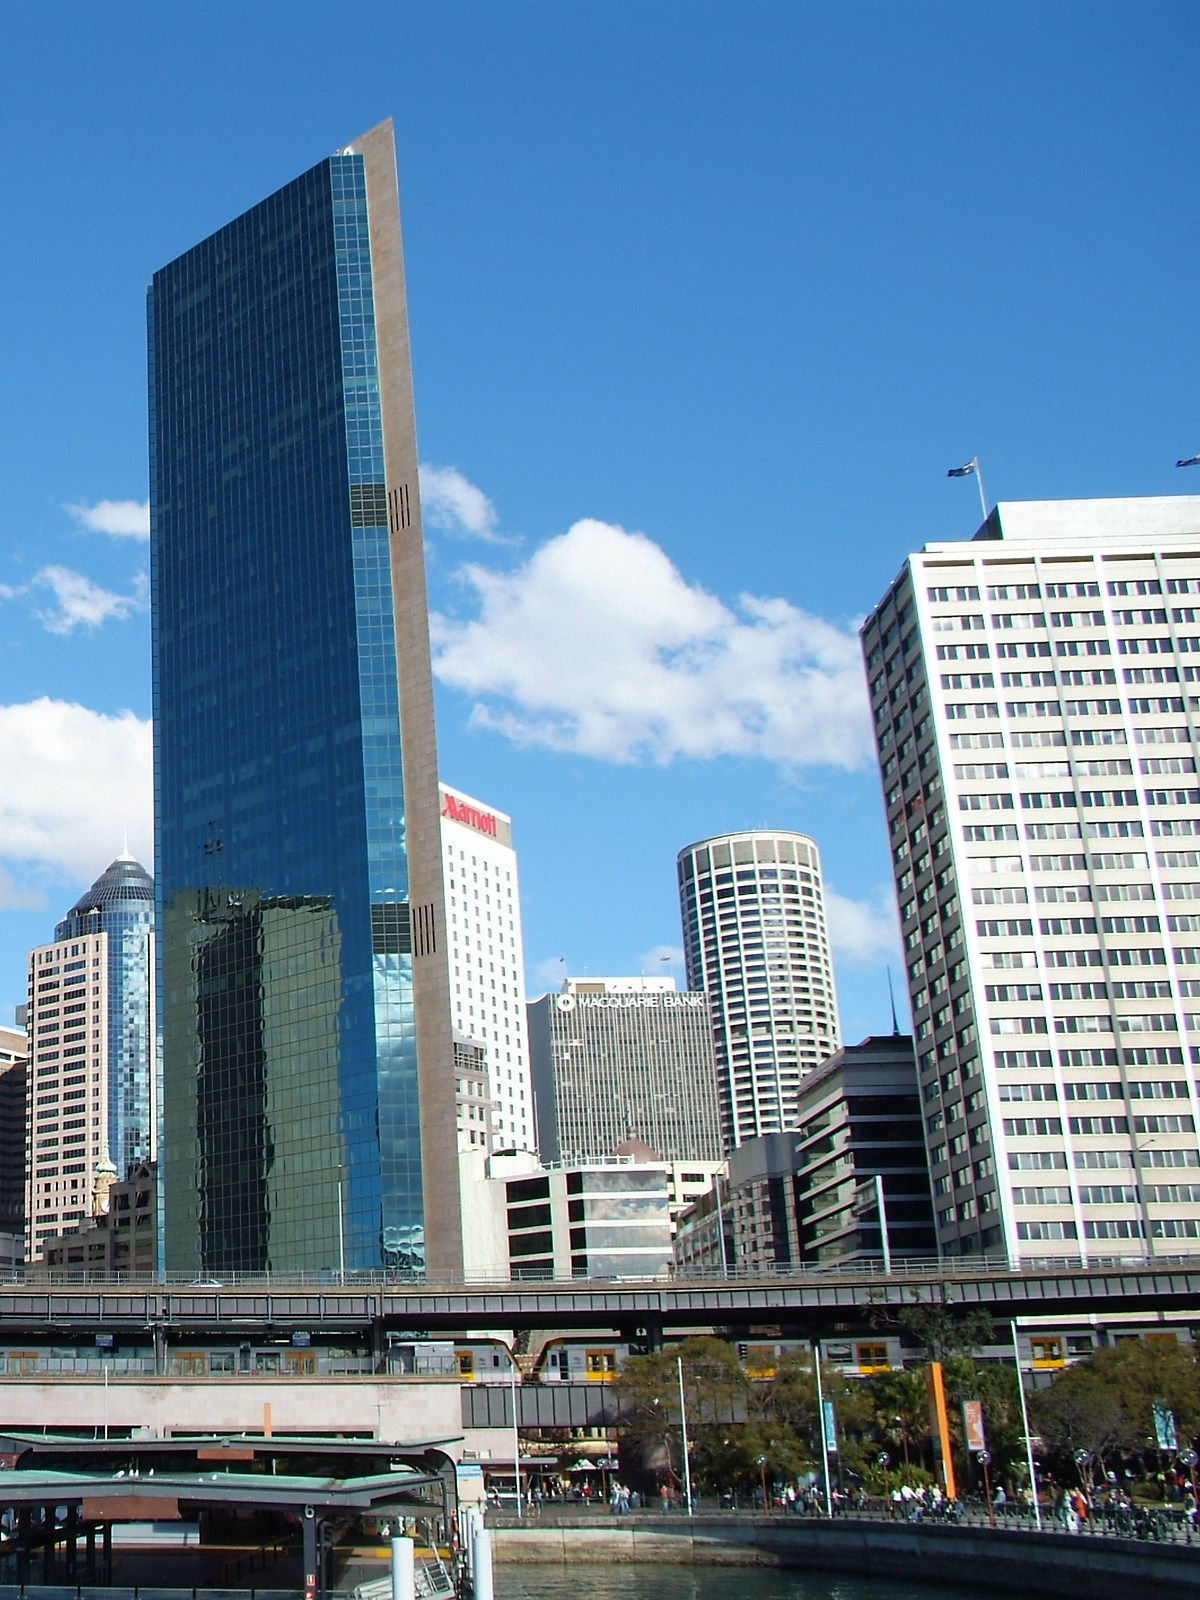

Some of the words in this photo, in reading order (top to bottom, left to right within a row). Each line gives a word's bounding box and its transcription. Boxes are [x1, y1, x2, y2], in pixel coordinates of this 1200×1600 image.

[578, 996, 660, 1008] MACQUARIE
[663, 996, 704, 1008] BANK
[304, 1504, 315, 1519] 6
